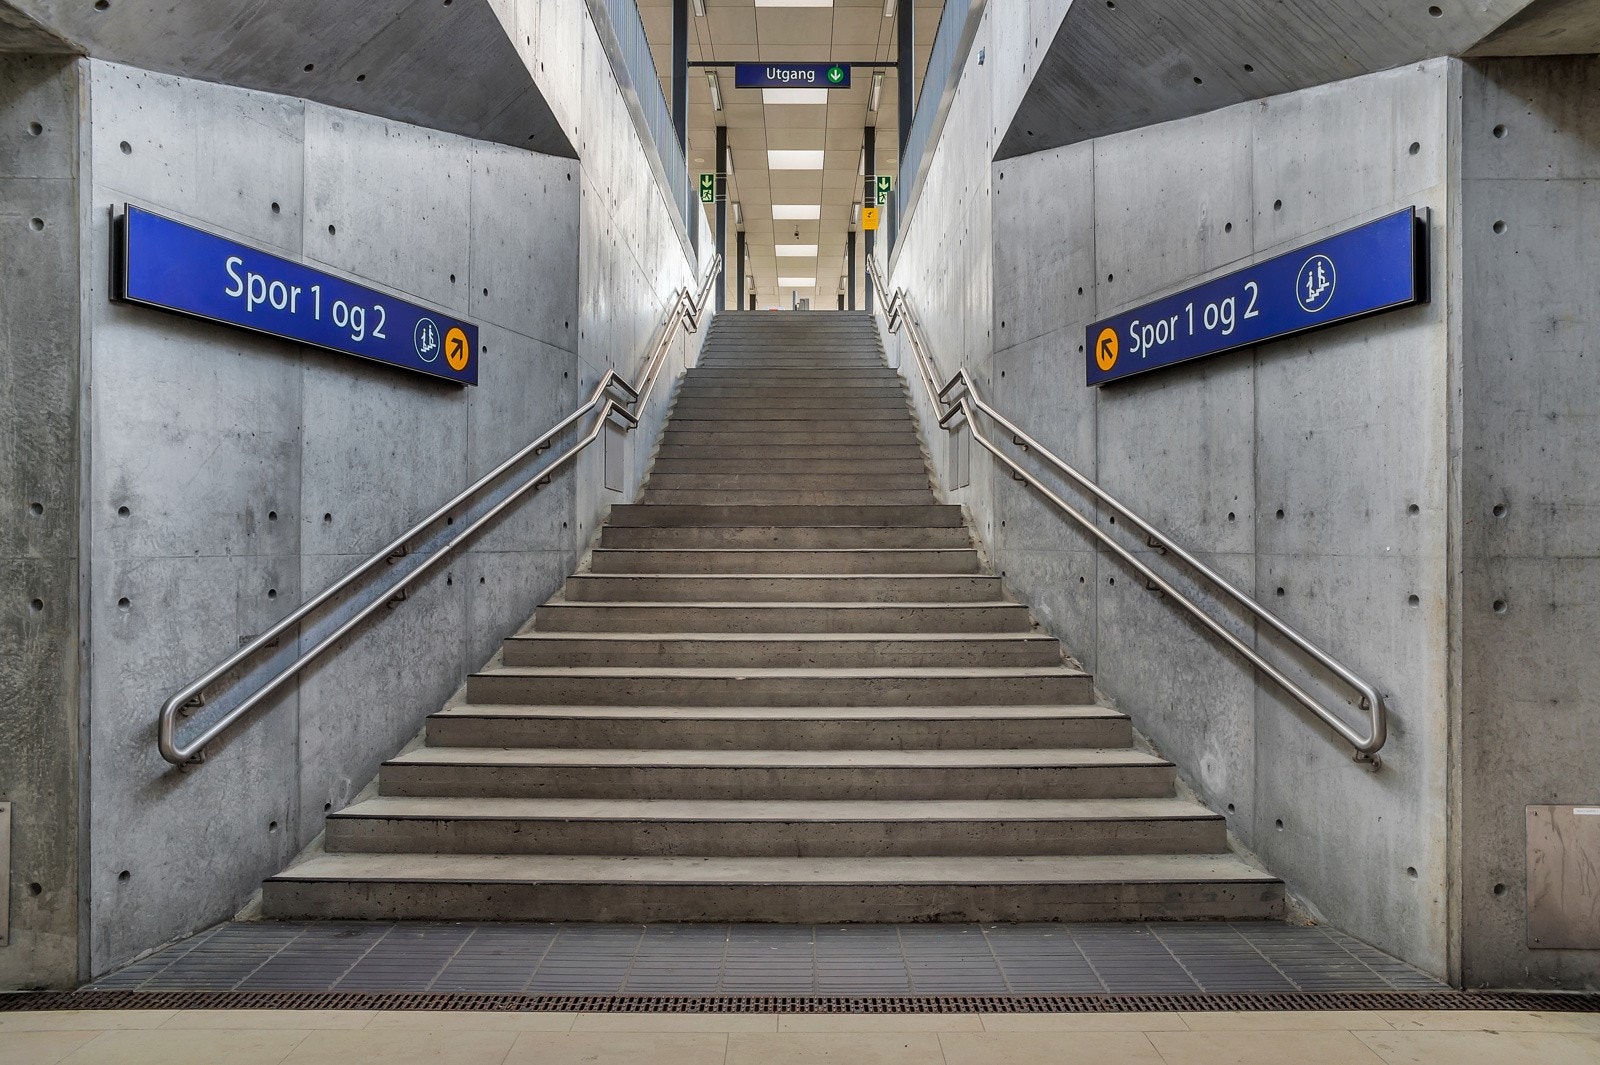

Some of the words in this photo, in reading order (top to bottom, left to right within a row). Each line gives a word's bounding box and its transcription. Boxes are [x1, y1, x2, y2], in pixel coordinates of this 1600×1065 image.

[766, 67, 815, 83] Utgang
[225, 256, 301, 313] Spor
[311, 285, 320, 321] 1
[332, 300, 366, 342] og
[372, 304, 386, 340] 2
[1129, 314, 1179, 358] Spor
[1185, 302, 1194, 336] 1
[1203, 295, 1236, 336] og
[1243, 281, 1259, 319] 2
